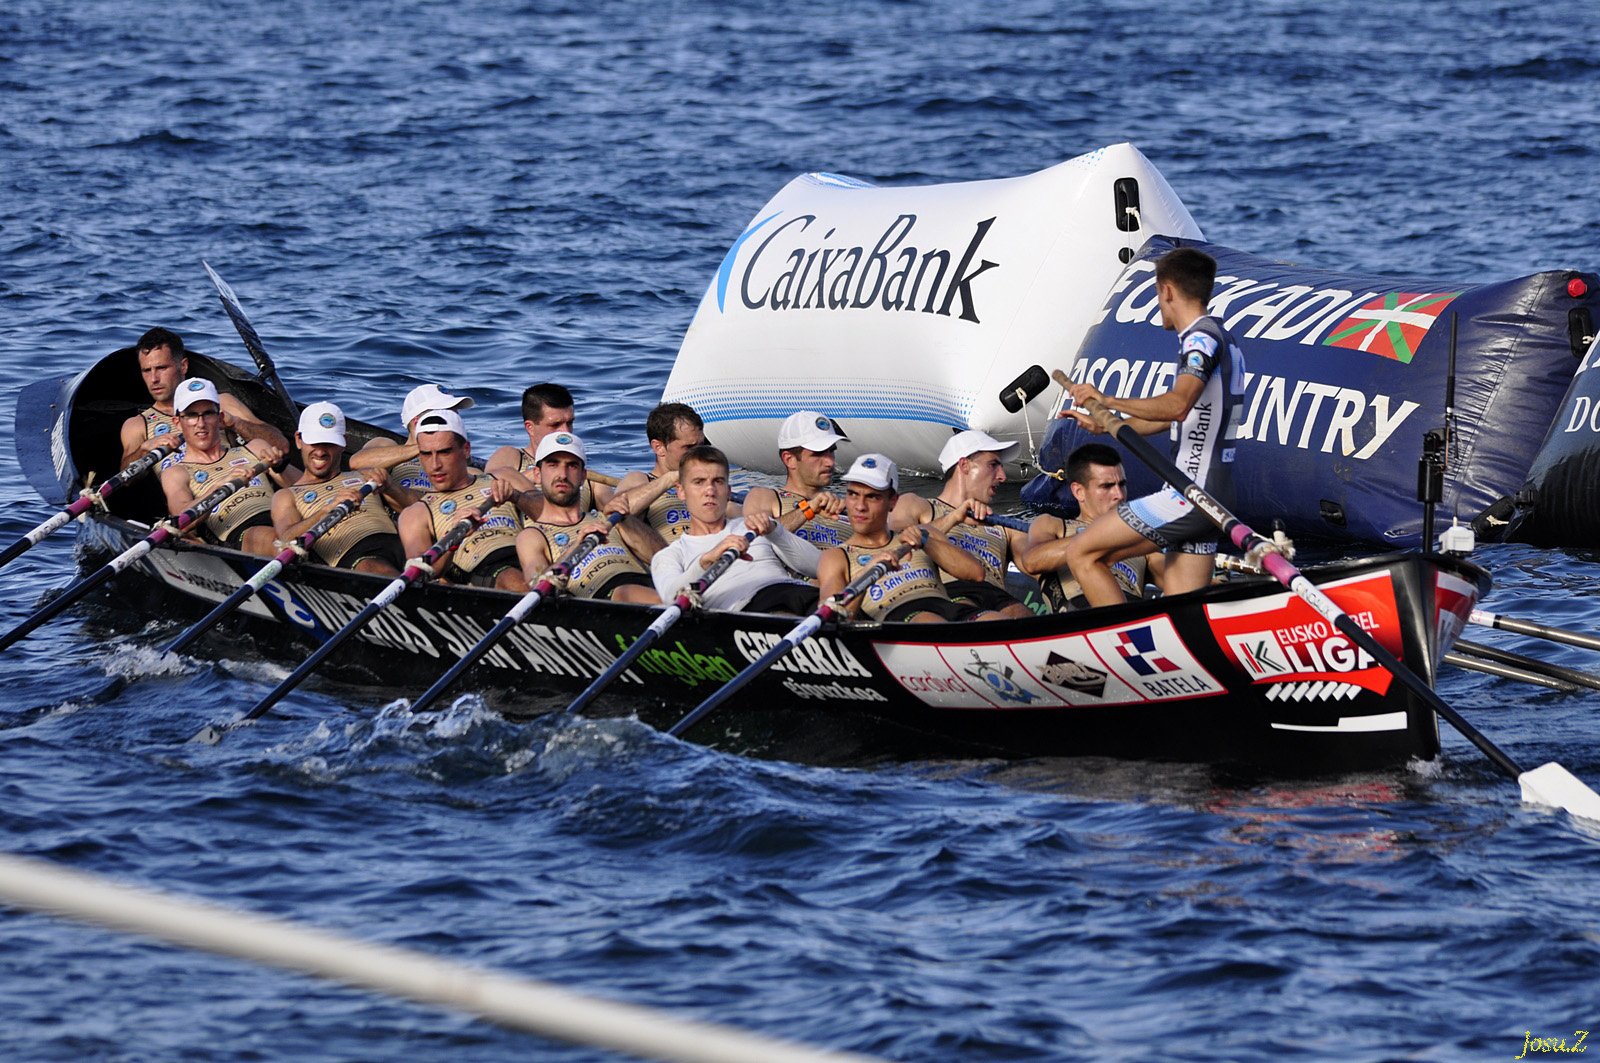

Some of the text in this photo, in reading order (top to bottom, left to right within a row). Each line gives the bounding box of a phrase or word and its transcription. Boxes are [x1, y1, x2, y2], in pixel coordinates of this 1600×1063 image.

[740, 213, 1000, 324] CaixaBank
[1236, 373, 1421, 460] UNTRY
[1185, 401, 1213, 480] aixaBank
[581, 547, 626, 567] SAN ANTON
[811, 531, 829, 544] SAN
[883, 575, 903, 591] SAN
[904, 568, 937, 581] ANTON
[1276, 610, 1380, 645] EUSKO LBEL
[494, 617, 644, 685] ANTON
[733, 629, 873, 678] GETARIA
[1142, 674, 1213, 697] BATELA
